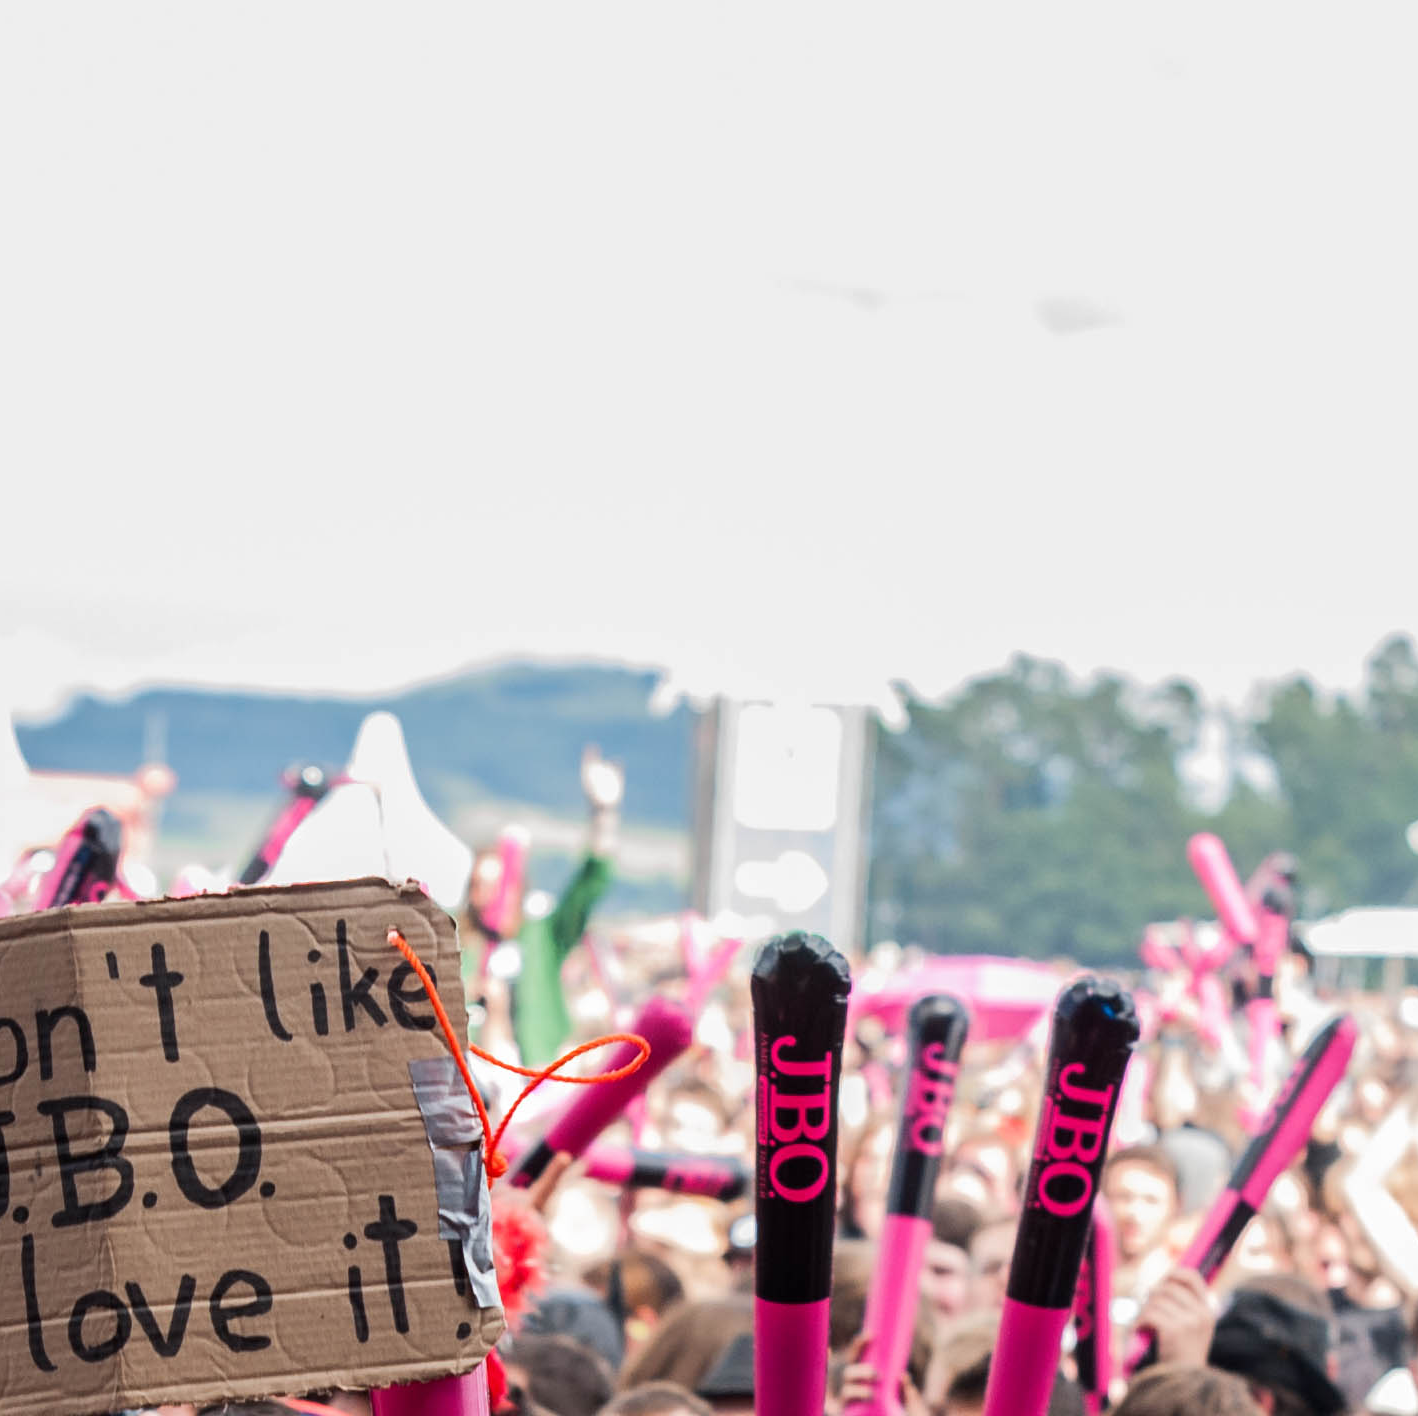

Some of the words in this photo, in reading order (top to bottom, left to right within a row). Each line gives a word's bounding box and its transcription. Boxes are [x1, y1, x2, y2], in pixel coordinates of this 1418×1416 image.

[259, 919, 437, 1041] like
[769, 1035, 832, 1203] J.B.O.
[1034, 1062, 1114, 1217] J.B.O.
[21, 1235, 273, 1372] love
[342, 1195, 472, 1344] it!
